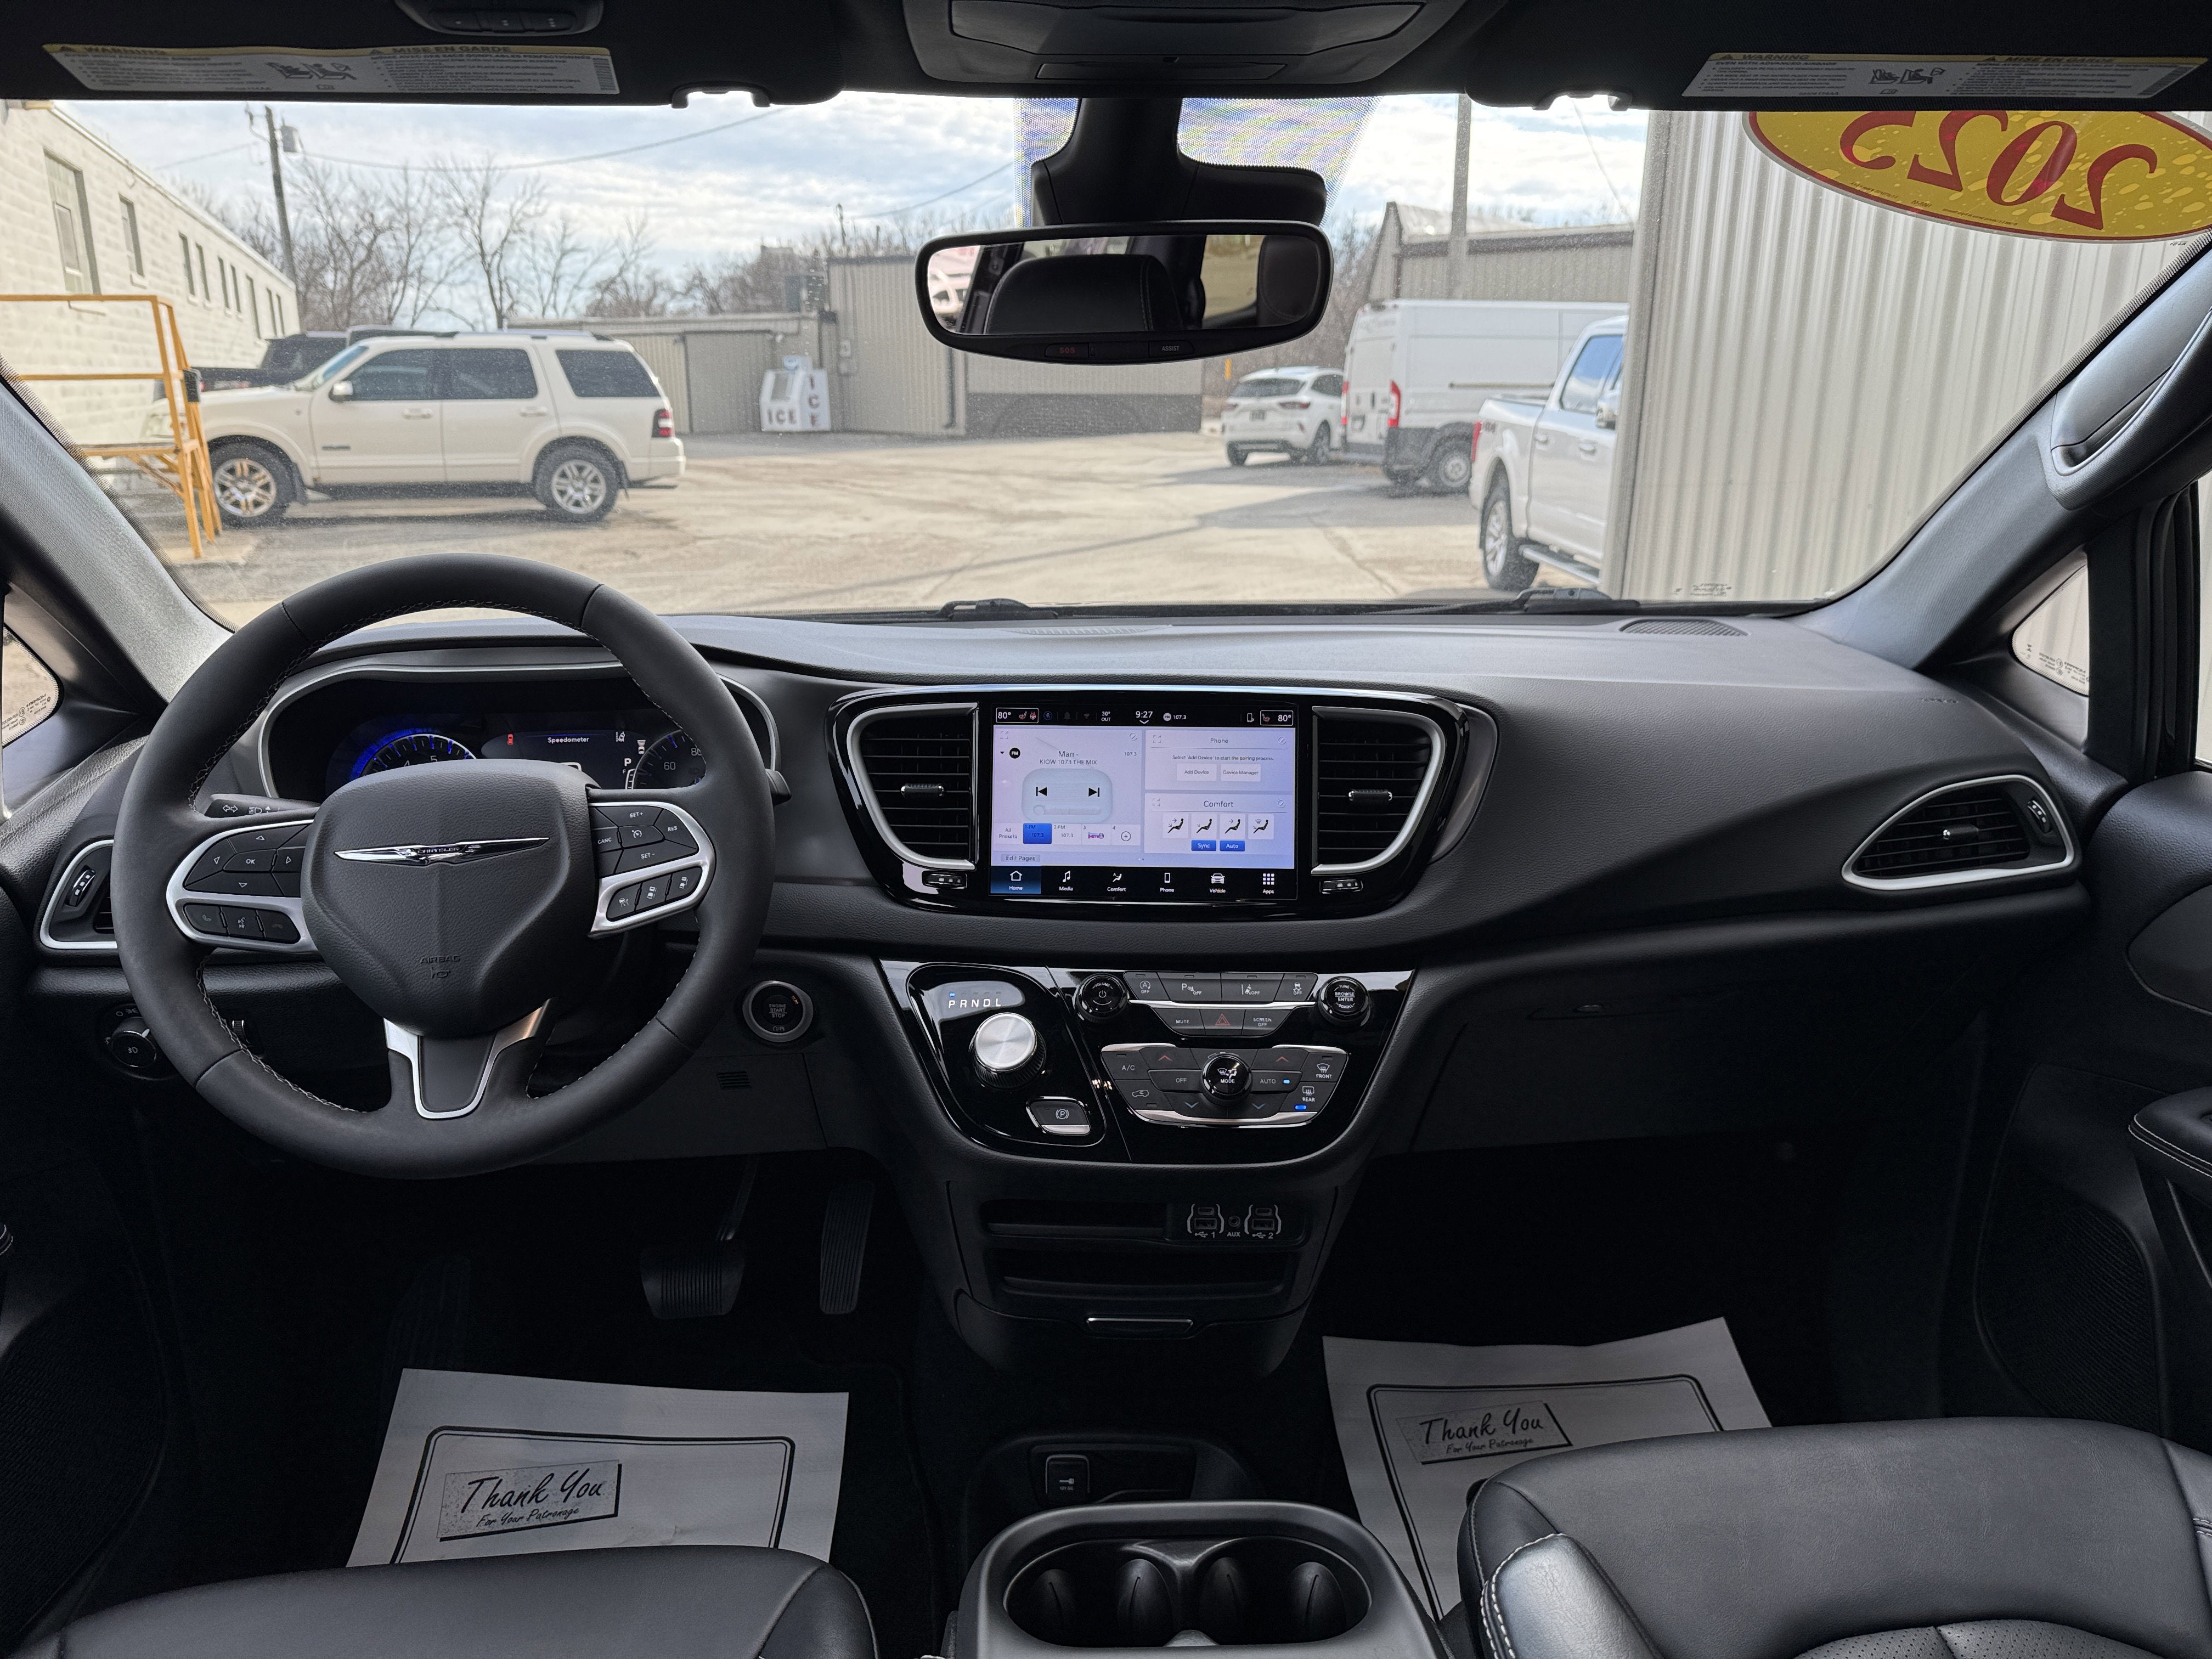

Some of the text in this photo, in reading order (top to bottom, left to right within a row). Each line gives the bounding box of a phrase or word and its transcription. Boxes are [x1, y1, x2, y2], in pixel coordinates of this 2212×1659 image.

[1136, 710, 1153, 719] 9:27
[548, 736, 590, 744] Speedometer
[624, 758, 632, 767] P
[663, 761, 676, 771] 60
[597, 837, 612, 845] CANC
[419, 955, 461, 964] AIRBAG
[1419, 1407, 1544, 1445] Thank You
[1446, 1438, 1533, 1454] For Your Patronage
[460, 1468, 602, 1514] Thank You
[475, 1506, 580, 1528] For Your Patronage
